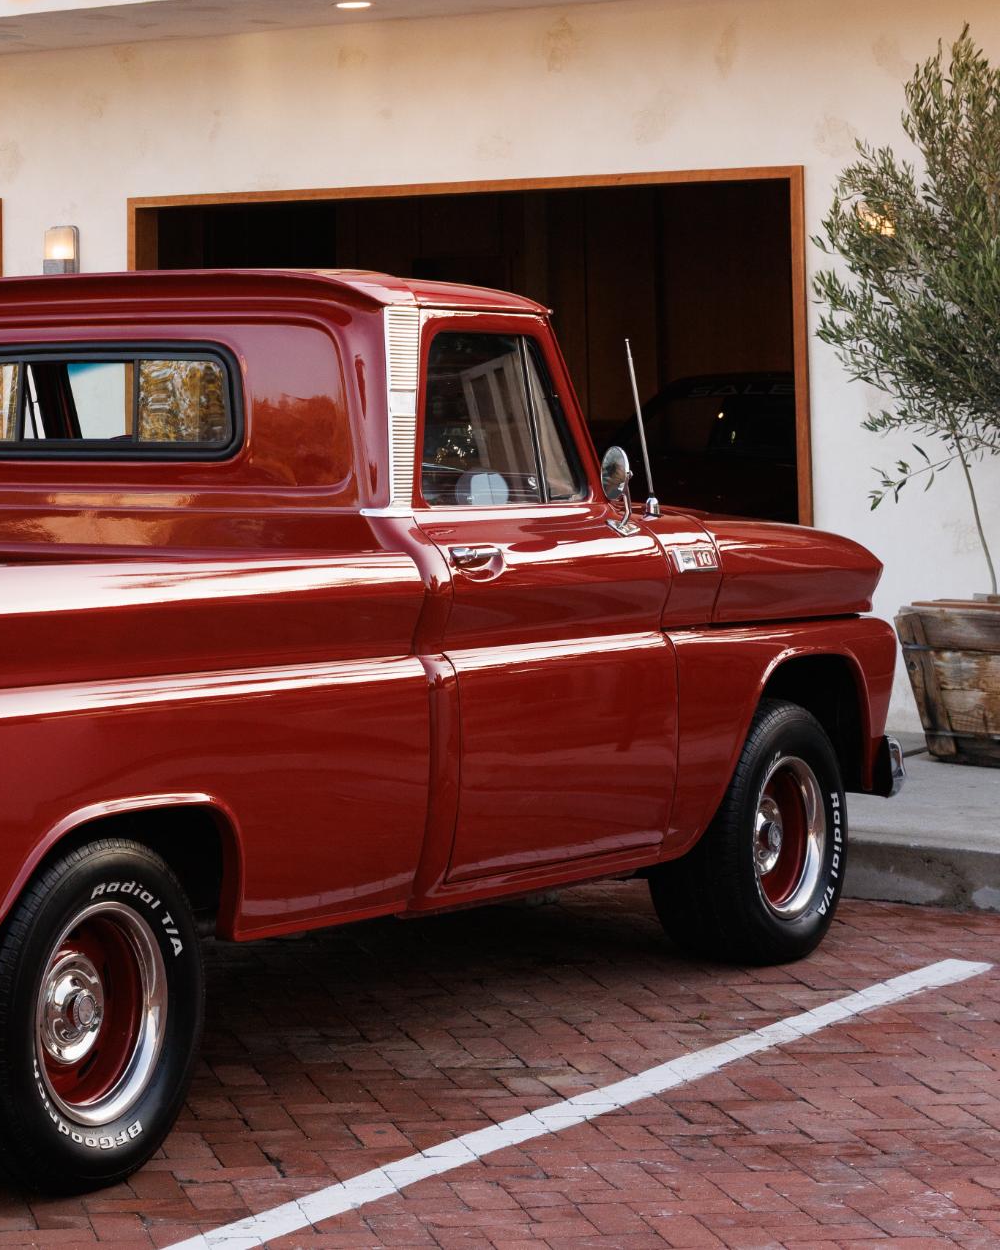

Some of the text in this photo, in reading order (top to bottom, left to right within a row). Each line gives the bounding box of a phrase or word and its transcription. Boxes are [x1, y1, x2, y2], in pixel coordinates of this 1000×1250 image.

[697, 551, 713, 566] 10
[816, 792, 842, 916] Radial T/A
[90, 881, 184, 957] Radial T/A
[33, 1059, 143, 1149] BFGoodrich
